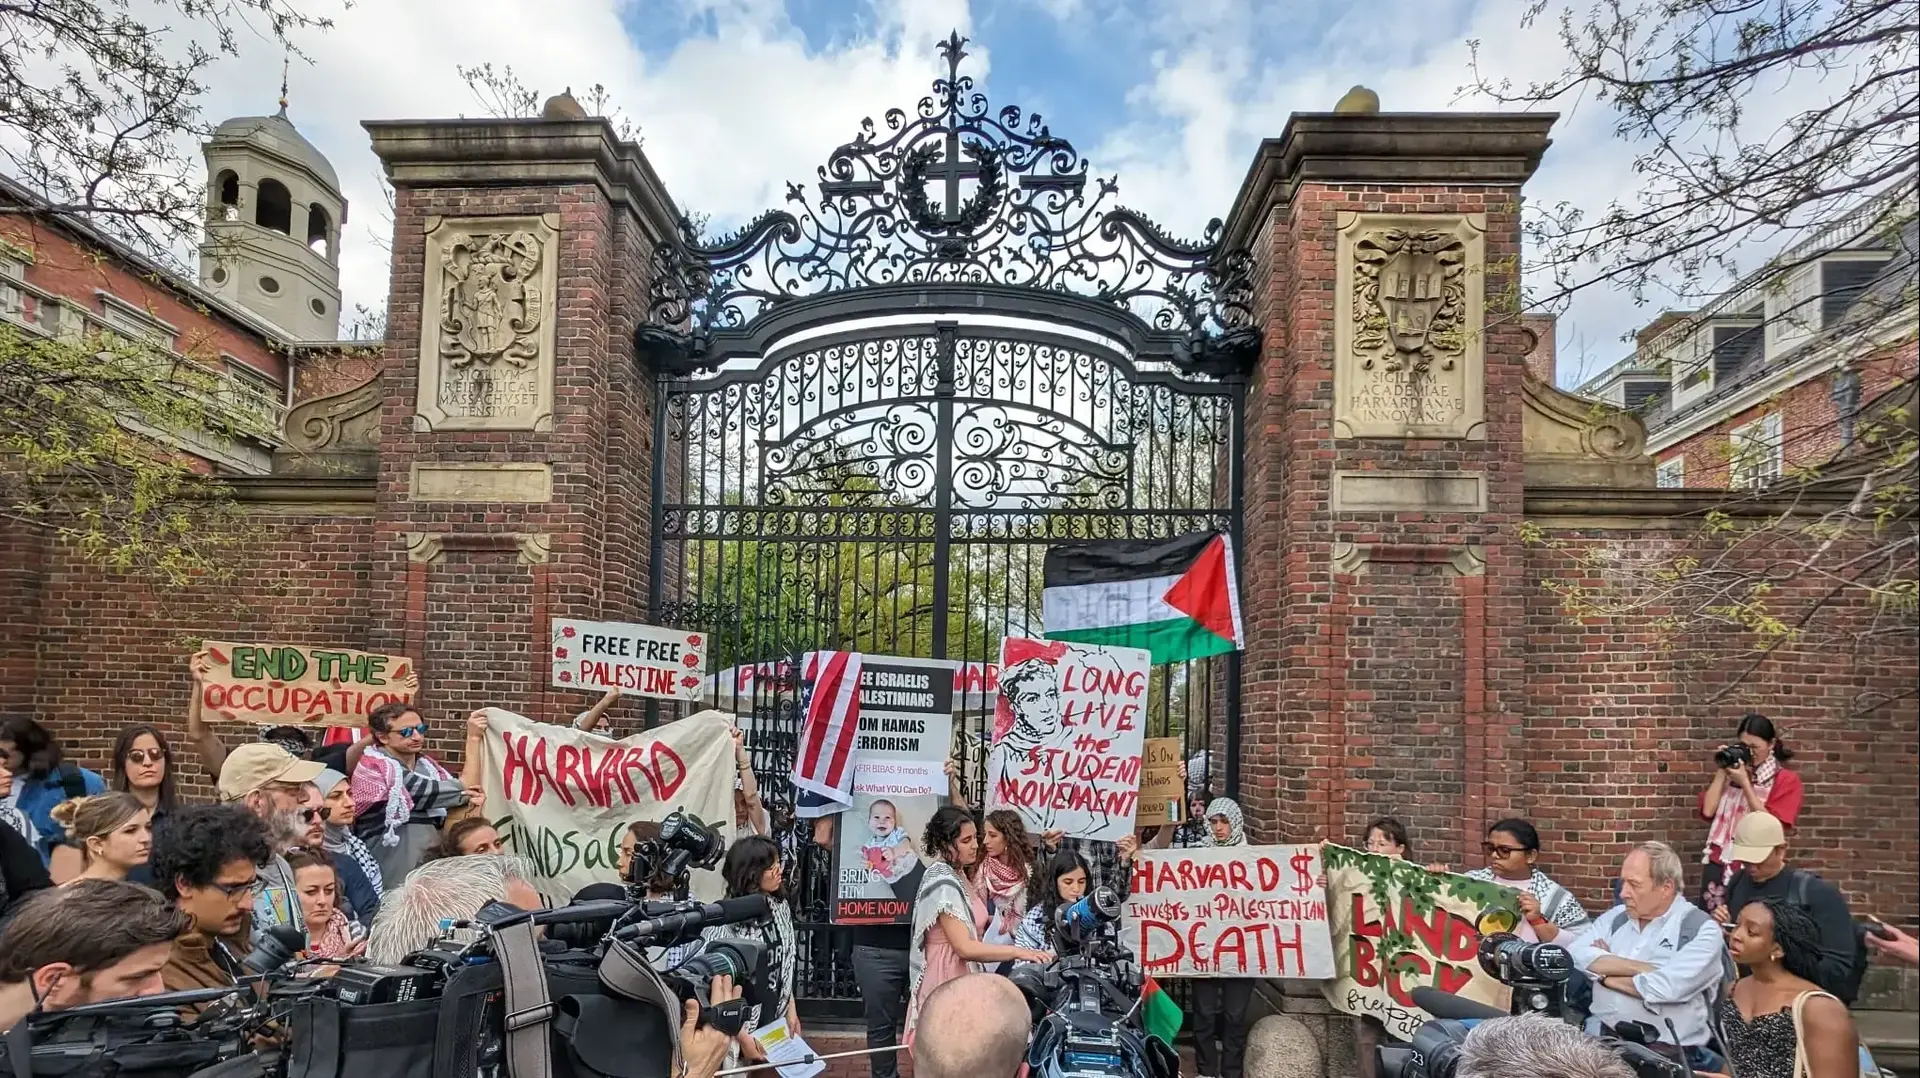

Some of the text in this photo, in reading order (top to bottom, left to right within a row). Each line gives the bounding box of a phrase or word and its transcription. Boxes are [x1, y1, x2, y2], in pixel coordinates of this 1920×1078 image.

[1360, 384, 1449, 397] ACADEMIAE
[1350, 396, 1462, 409] HARVARDIANAE
[582, 634, 681, 662] FREE FREE
[231, 646, 389, 686] END THE
[580, 659, 678, 695] PALESTINE
[875, 671, 930, 690] ISRAELIS
[1062, 664, 1146, 699] LONG
[859, 689, 934, 707] ALESTINIANS
[881, 718, 925, 734] HAMAS
[1062, 700, 1141, 731] LIVE
[857, 735, 920, 752] ERRORISM
[1073, 733, 1112, 754] the
[502, 730, 688, 808] HARVARD
[872, 765, 895, 774] BIBAS
[902, 766, 929, 775] months
[1020, 744, 1143, 786] STUDENT
[865, 784, 886, 793] What
[886, 785, 902, 793] YOU
[904, 786, 918, 794] Can
[918, 786, 932, 794] Do?
[995, 776, 1139, 818] MOVEMENT
[839, 869, 882, 884] BRING
[1130, 848, 1314, 897] HARVARD $
[839, 885, 864, 898] HIM
[838, 902, 909, 915] HOME NOW
[1195, 902, 1212, 919] IN
[1214, 893, 1325, 921] PALESTINIAN
[1351, 892, 1480, 962] LAND
[1141, 920, 1306, 976] DEATH
[1412, 1050, 1424, 1067] 23
